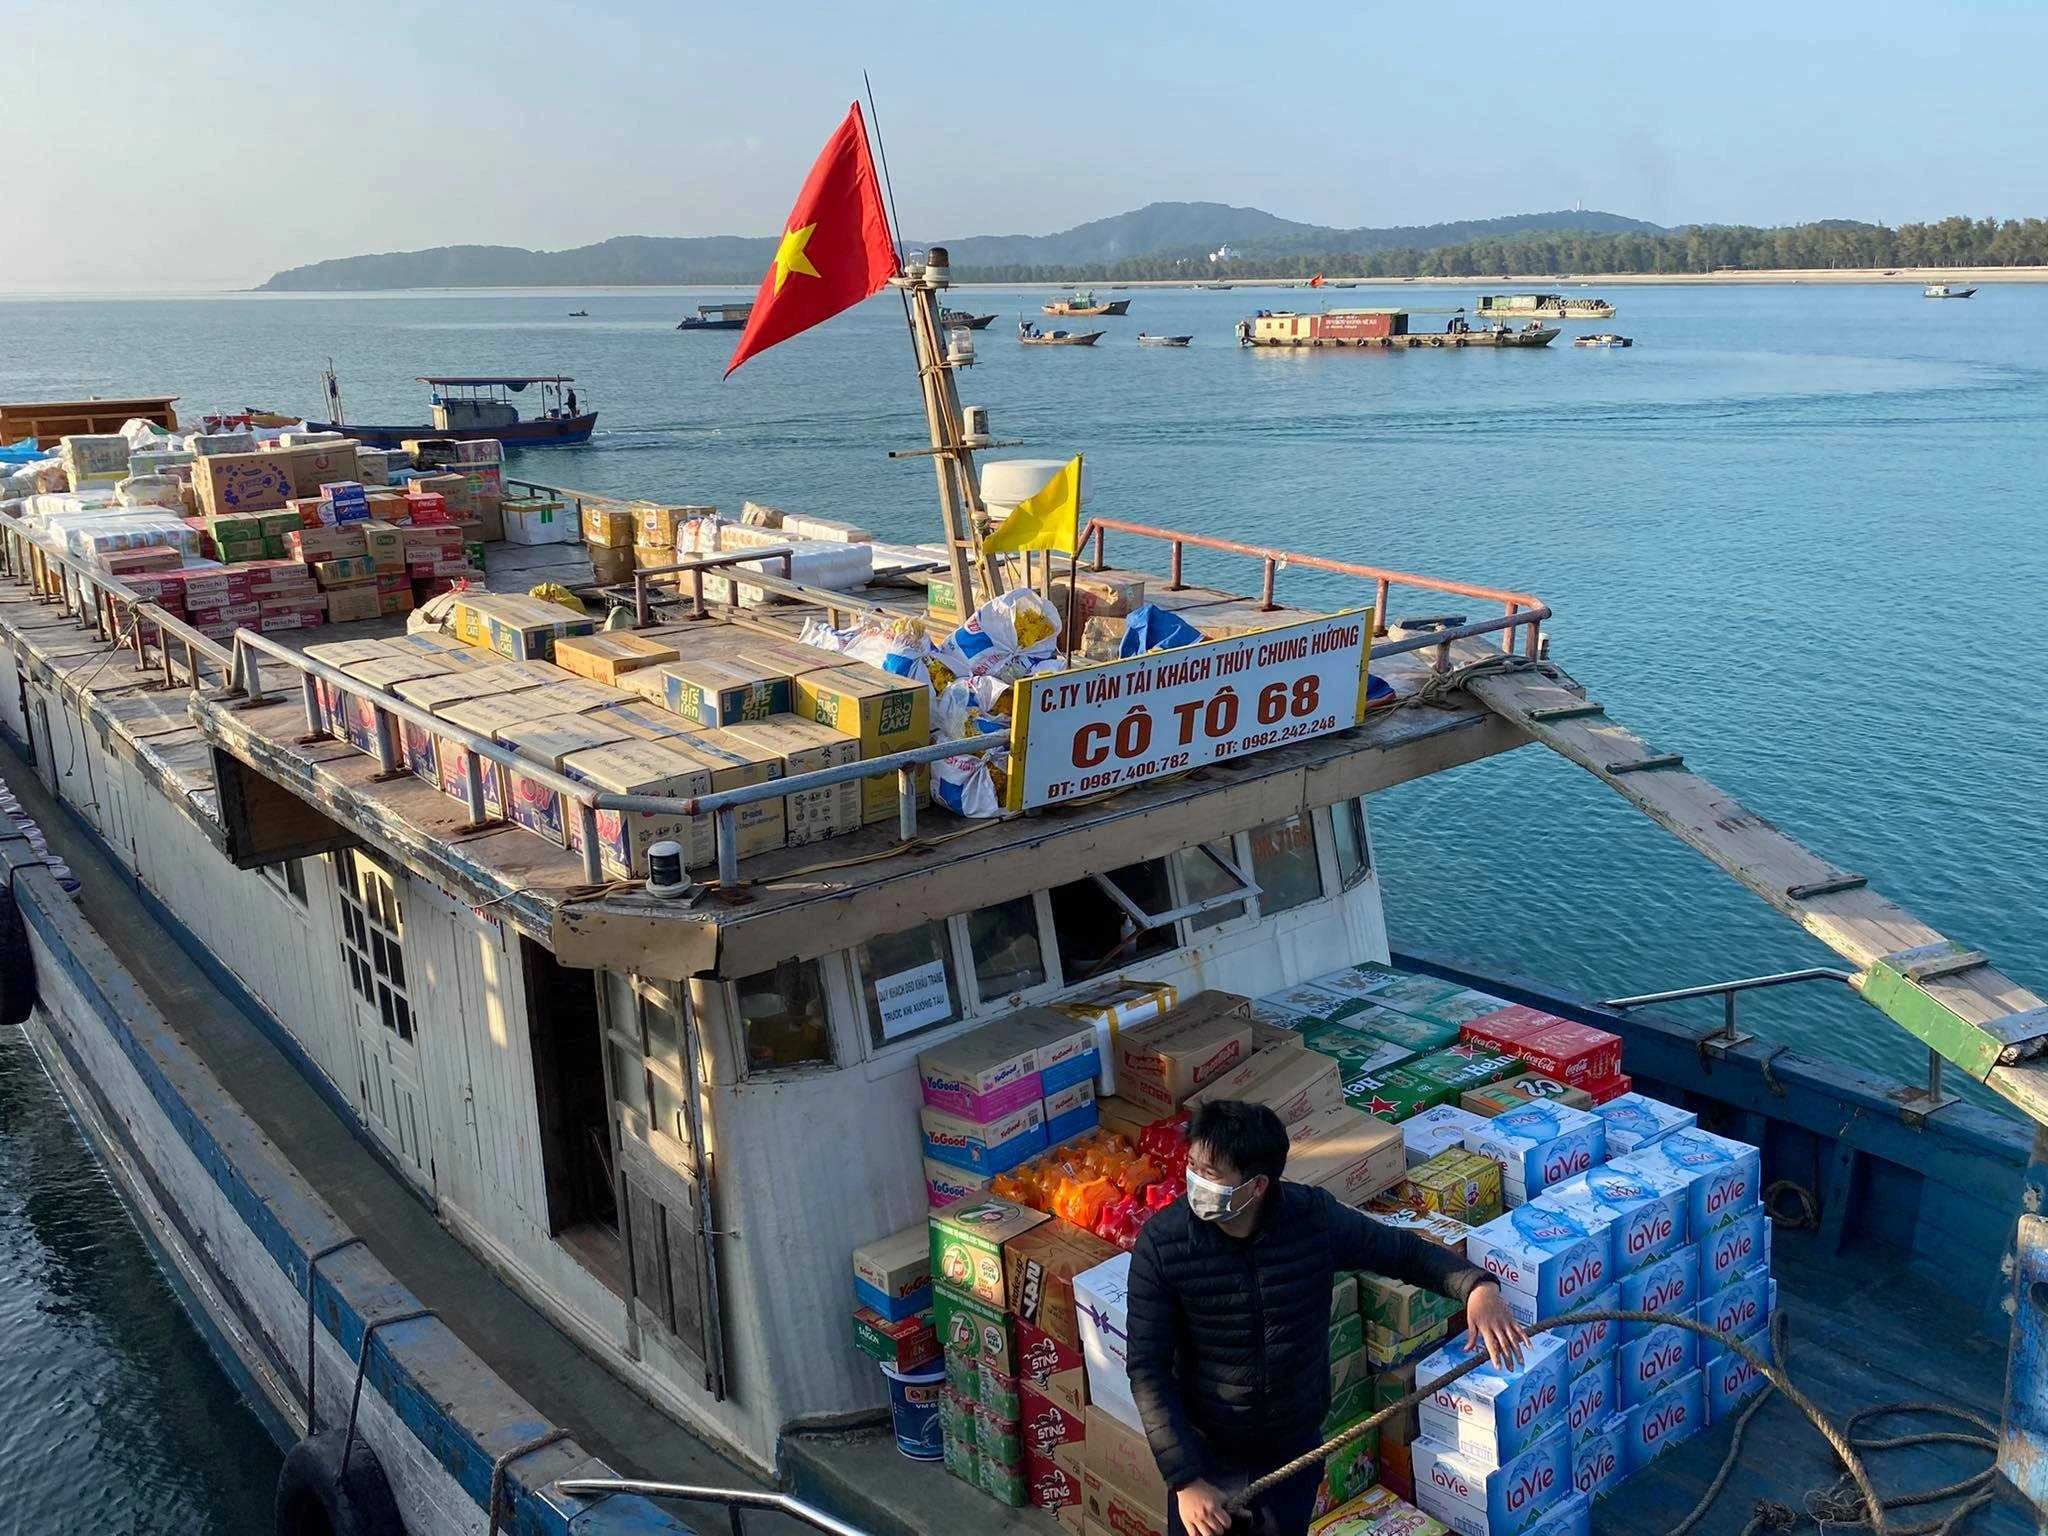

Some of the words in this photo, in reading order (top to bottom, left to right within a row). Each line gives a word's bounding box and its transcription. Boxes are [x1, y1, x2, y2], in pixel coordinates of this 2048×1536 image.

[1041, 683, 1081, 713] C.TY
[1086, 673, 1121, 708] VẬN
[1126, 662, 1152, 696] TẢI
[1156, 657, 1211, 690] KHÁCH
[1216, 642, 1254, 677] THỦY
[1258, 636, 1308, 668] CHUNG
[1072, 704, 1153, 769] CÔ
[1174, 685, 1239, 746] TÔ
[1258, 675, 1320, 725] 68
[926, 1075, 961, 1093] YoGood
[928, 1131, 967, 1147] YoGood
[1544, 1149, 1591, 1185] laVie
[931, 1179, 966, 1197] YoGood
[1707, 1178, 1746, 1214] laVie
[1628, 1216, 1672, 1254] laVie
[1716, 1234, 1751, 1271] laVie
[1484, 1256, 1520, 1283] laVie
[1558, 1258, 1603, 1298] laVie
[1642, 1278, 1685, 1313] laVie
[1716, 1299, 1757, 1334] laVie
[1568, 1318, 1607, 1361] laVie
[1031, 1351, 1060, 1371] STING
[1640, 1344, 1682, 1382] laVie
[1516, 1382, 1557, 1429] laVie
[1568, 1387, 1604, 1432] laVie
[1642, 1404, 1686, 1443] laVie
[1037, 1424, 1066, 1441] STING
[1431, 1468, 1469, 1497] laVie
[1506, 1465, 1554, 1513] laVie
[1575, 1454, 1616, 1494] laVie
[1042, 1485, 1071, 1501] STING
